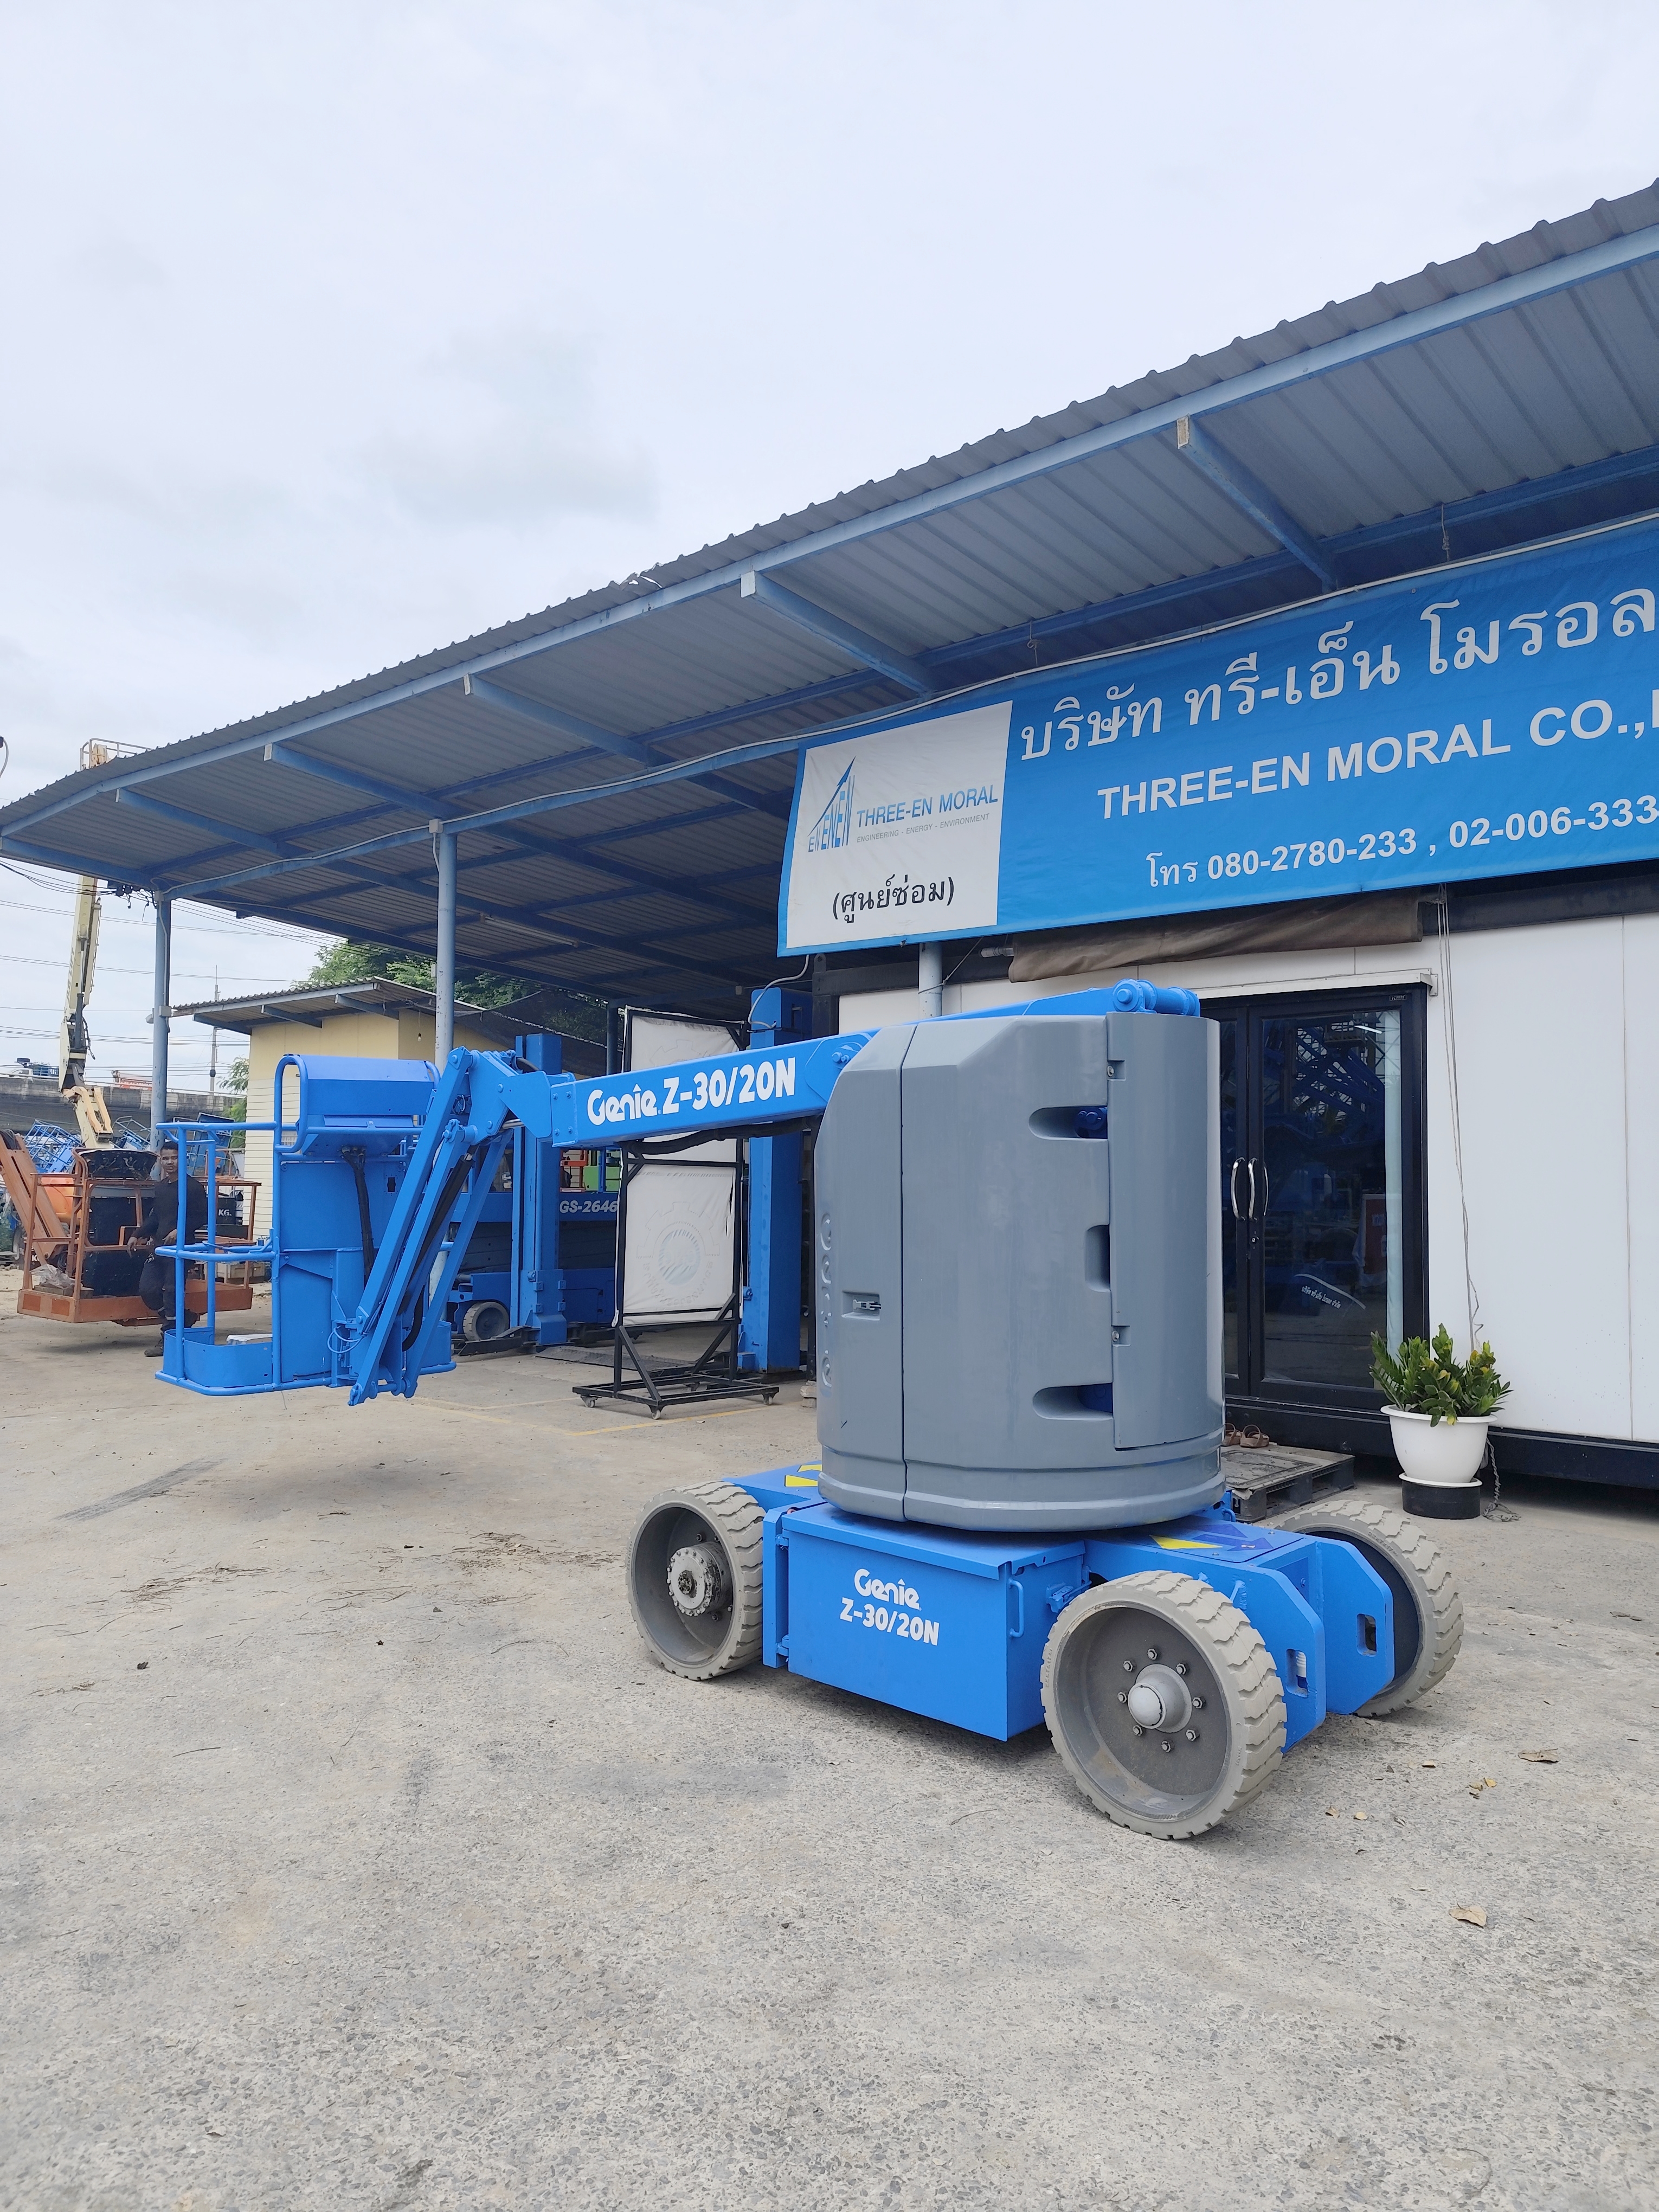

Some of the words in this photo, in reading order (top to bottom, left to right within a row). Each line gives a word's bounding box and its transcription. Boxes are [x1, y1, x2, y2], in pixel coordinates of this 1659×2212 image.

[1021, 683, 1162, 760] บริษัท
[1184, 620, 1400, 725] ทรี-เอ็น
[1419, 588, 1656, 674] โมรอล
[1097, 751, 1310, 819] THREE-EN
[1327, 718, 1511, 782] MORAL
[1529, 689, 1659, 747] CO.,
[857, 796, 933, 828] THREE-EN
[939, 785, 998, 813] MORAL
[857, 829, 899, 843] ENGINEERING
[906, 823, 933, 834] ENERGY
[940, 813, 990, 828] ENVIRONMENT
[1146, 852, 1199, 887] โทร
[1207, 828, 1417, 879] 080-2780-233
[1449, 795, 1659, 848] 02-006-333
[833, 873, 954, 923] (ศูนย์ซ่อม)
[587, 1084, 658, 1126] Genie
[663, 1057, 795, 1115] Z-30/20N
[560, 1200, 618, 1213] GS-2646
[854, 1568, 919, 1610] Genie
[840, 1597, 940, 1646] Z-30/20N
